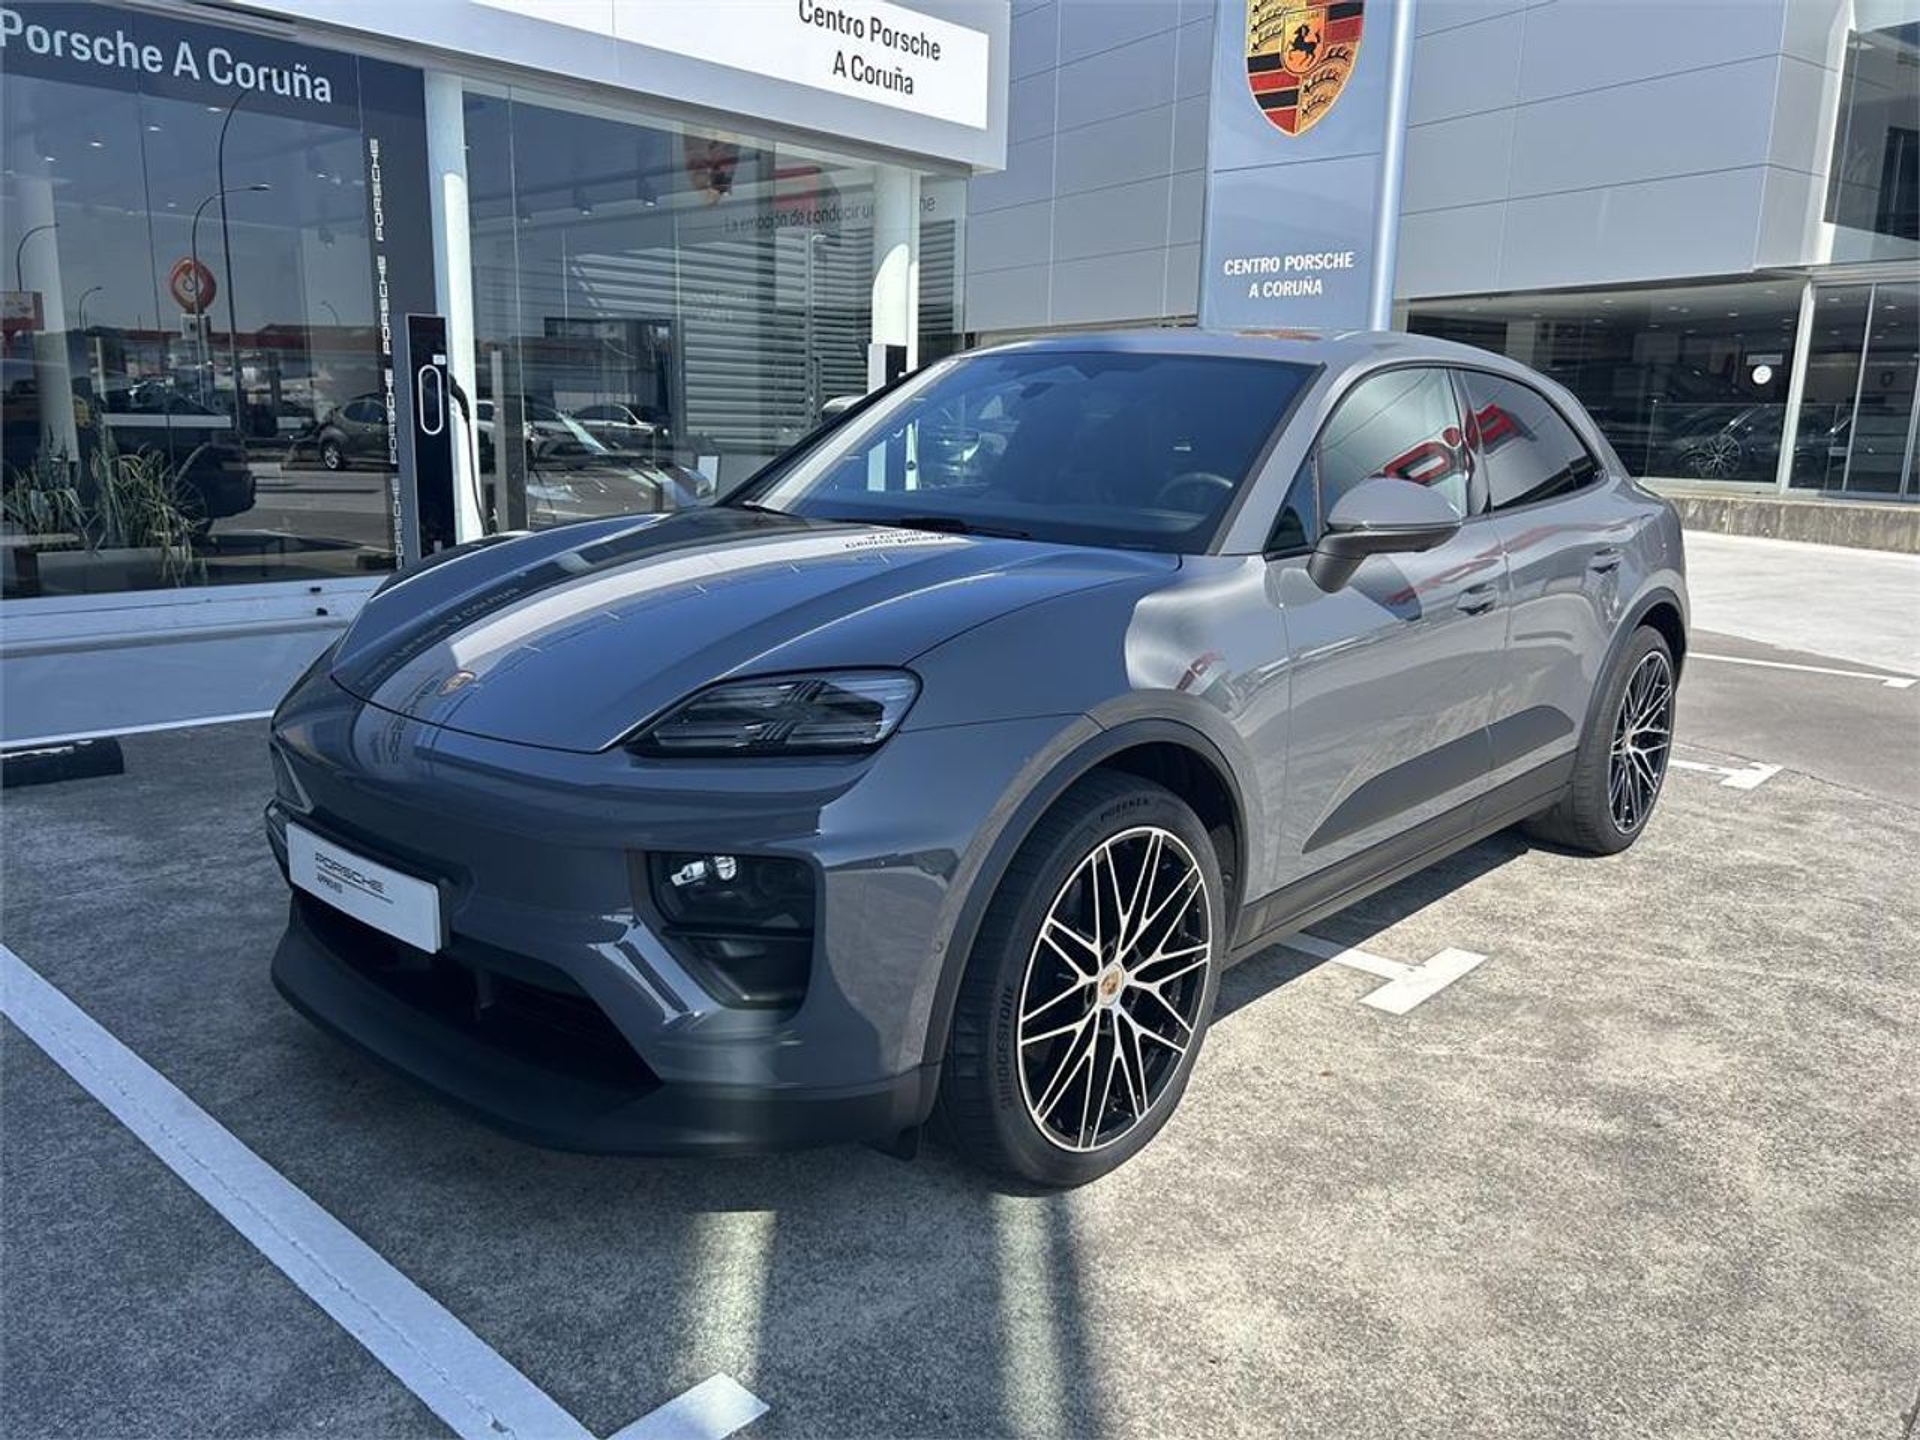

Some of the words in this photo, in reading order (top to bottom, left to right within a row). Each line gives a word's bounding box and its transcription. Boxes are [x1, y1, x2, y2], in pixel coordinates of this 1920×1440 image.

[0, 9, 163, 73] Porsche
[173, 41, 200, 80] A
[207, 48, 332, 103] Coruña
[799, 0, 865, 39] Centro
[870, 16, 942, 61] Porsche
[832, 50, 847, 78] A
[851, 55, 914, 95] Coruña
[370, 138, 384, 241] PORSCHE
[1223, 255, 1280, 276] CENTRO
[1284, 252, 1354, 273] PORSCHE
[1249, 283, 1260, 299] A
[1263, 276, 1322, 298] CORUÑA
[377, 255, 391, 355] PORSCHE
[384, 368, 397, 465] PORSCHE
[314, 851, 386, 895] PORSCHE
